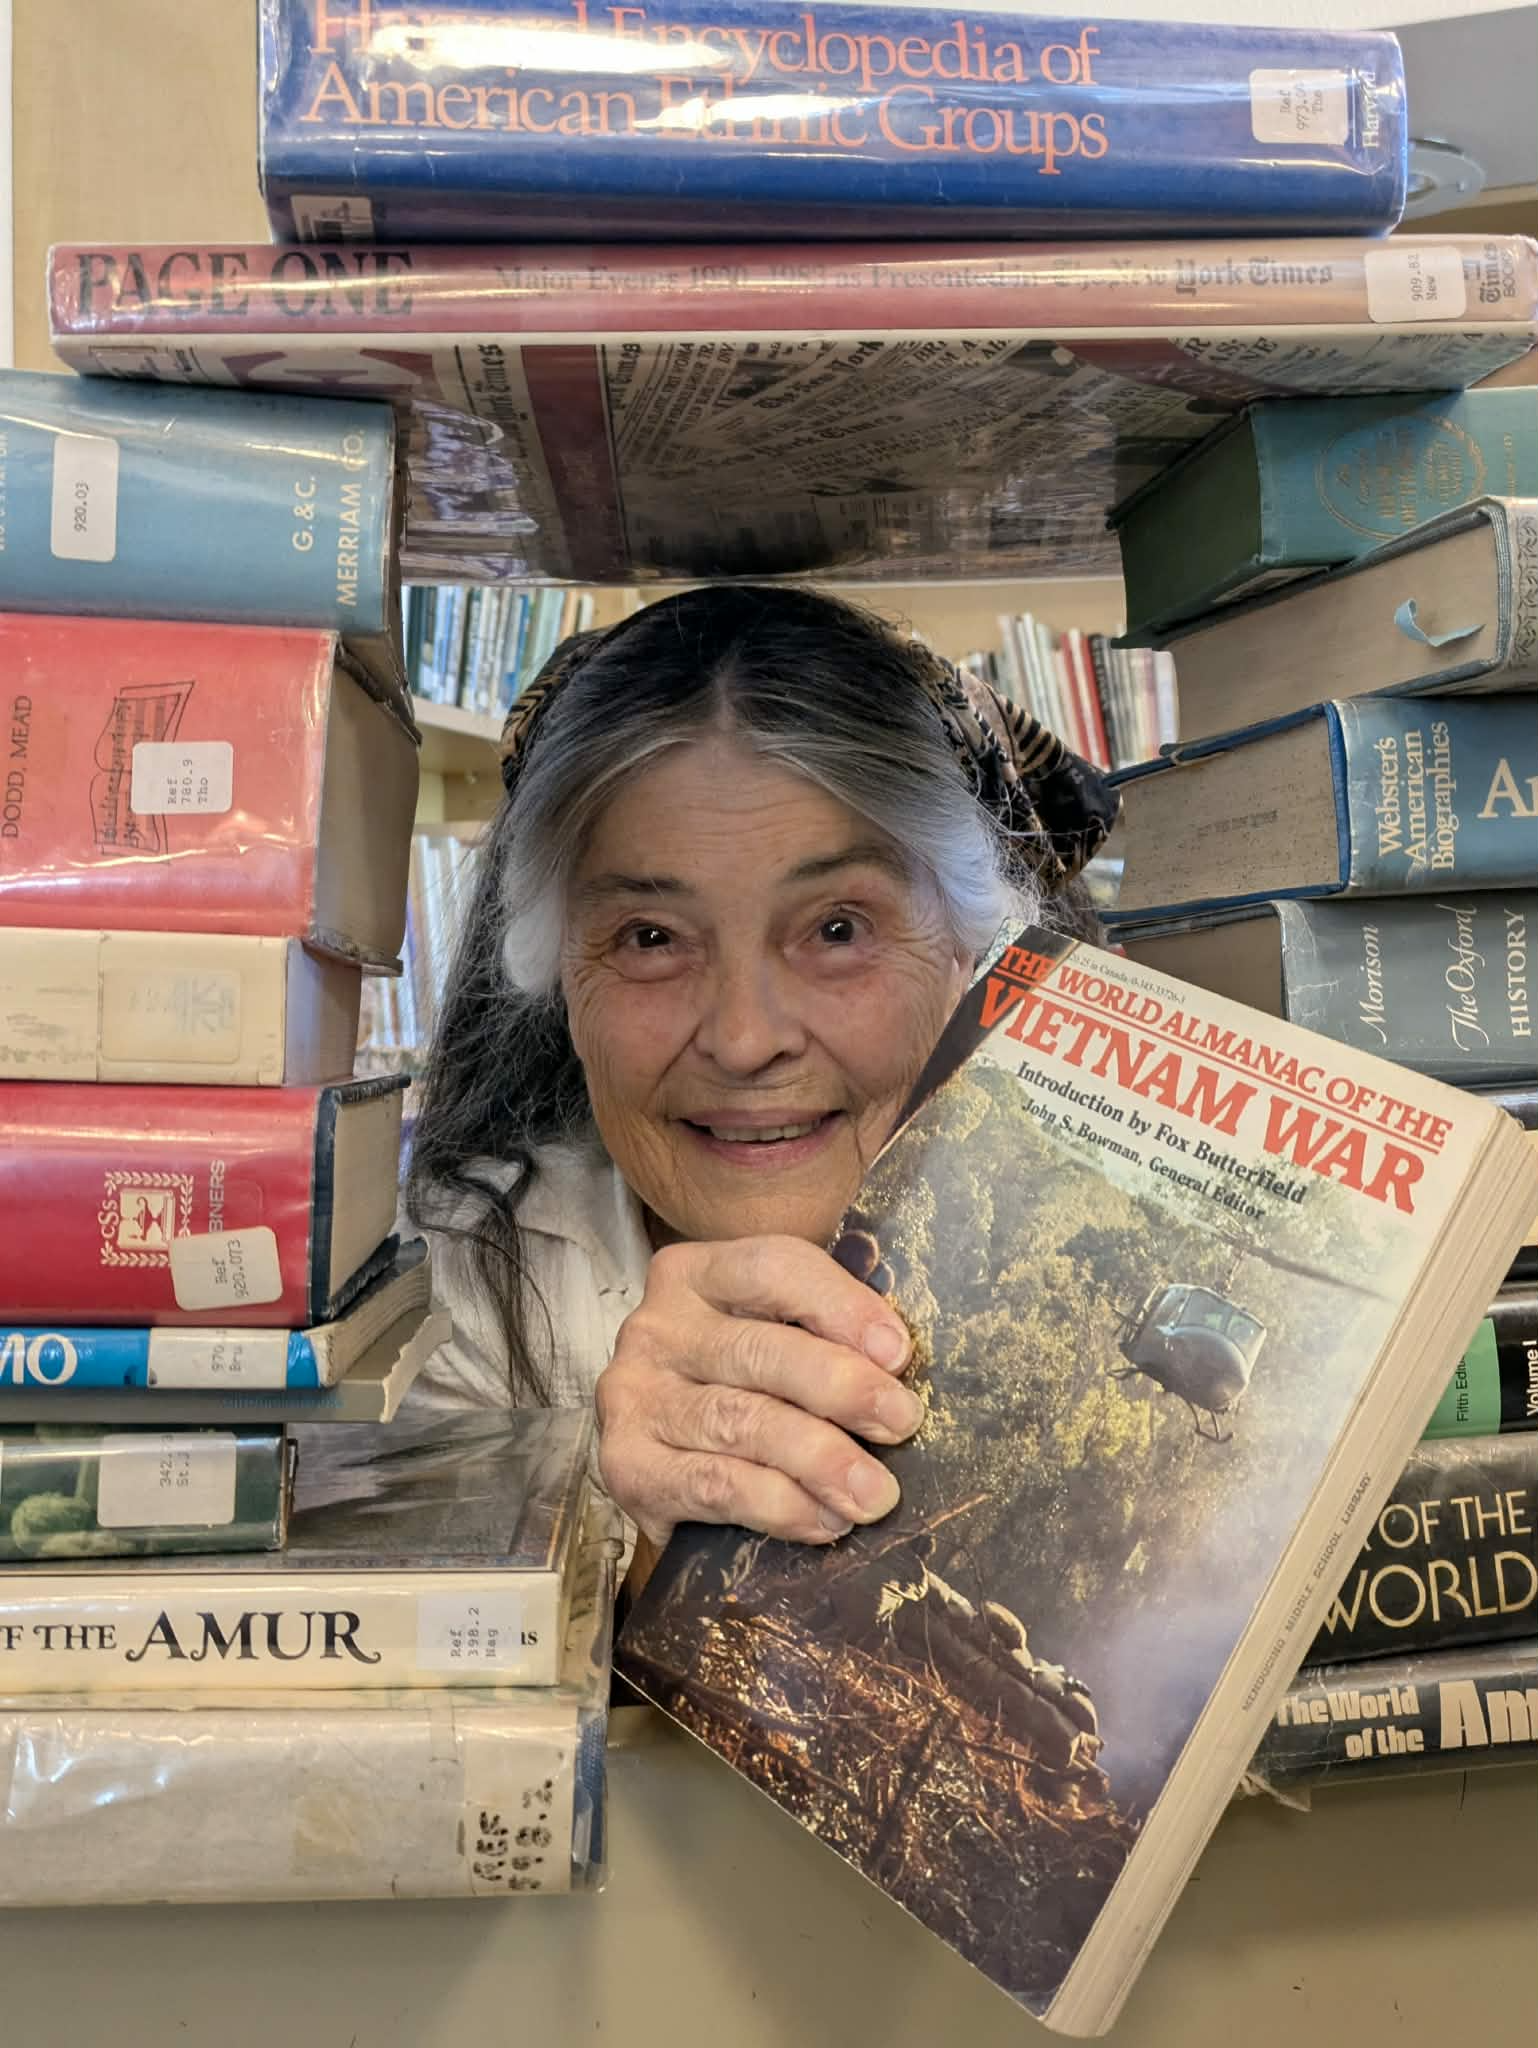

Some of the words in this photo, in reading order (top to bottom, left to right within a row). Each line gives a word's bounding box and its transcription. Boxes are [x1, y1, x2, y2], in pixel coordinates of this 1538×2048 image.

[1039, 26, 1102, 86] of
[300, 62, 637, 137] American
[655, 73, 868, 147] Ethnic
[877, 84, 1108, 174] Groups
[1360, 71, 1380, 148] Harvard
[77, 251, 248, 318] PAGE
[271, 250, 414, 317] ONE
[493, 264, 577, 296] Major
[834, 269, 863, 289] as
[872, 262, 1003, 289] Presented
[1175, 257, 1244, 297] York
[1248, 256, 1334, 286] Times
[1426, 275, 1439, 303] New
[1479, 242, 1502, 304] Times
[1503, 250, 1517, 299] BOOKS
[74, 481, 90, 533] 920.03
[294, 476, 316, 499] C.
[294, 498, 316, 521] &
[292, 525, 314, 552] G.
[337, 482, 363, 607] MERRIAM
[1, 762, 28, 840] DODD,
[18, 694, 34, 759] MEAD
[168, 775, 178, 805] Ref
[181, 758, 194, 805] 780.9
[197, 776, 209, 804] Tho
[1373, 736, 1403, 857] Webster's
[1400, 728, 1428, 865] American
[1426, 720, 1460, 871] Biographies
[1440, 903, 1487, 992] Oxford
[1500, 910, 1531, 1037] HISTORY
[1358, 922, 1387, 1045] Morison
[1000, 944, 1055, 985] THE
[1056, 965, 1164, 1024] WORLD
[1160, 1010, 1325, 1095] ALMANAC
[1325, 1078, 1378, 1112] OF
[1377, 1094, 1454, 1149] THE
[1447, 984, 1490, 1052] The
[977, 975, 1259, 1137] VIETNAM
[1262, 1095, 1426, 1215] WAR
[1016, 1061, 1136, 1123] Introduction
[1132, 1112, 1154, 1137] by
[1156, 1120, 1192, 1154] Fox
[1193, 1142, 1308, 1206] Butterfield
[1022, 1098, 1057, 1128] John
[1059, 1113, 1074, 1134] S.
[1076, 1120, 1144, 1167] Bowman,
[1149, 1155, 1208, 1195] General
[1207, 1182, 1267, 1221] Editor
[213, 1257, 229, 1284] Ref
[228, 1238, 250, 1299] 920.073
[1456, 1392, 1469, 1422] Fifth
[1526, 1348, 1538, 1417] Volume
[1378, 1498, 1443, 1549] OF
[1451, 1489, 1532, 1540] THE
[1285, 1585, 1314, 1634] MIDDLE
[1313, 1531, 1344, 1579] SCHOOL
[1341, 1472, 1372, 1525] LIBRARY
[1323, 1551, 1538, 1635] WORLD
[33, 1623, 117, 1651] THE
[126, 1610, 382, 1664] AMUR
[450, 1628, 463, 1658] Ref
[467, 1606, 480, 1658] 398.2
[1277, 1695, 1328, 1727] The
[1327, 1684, 1421, 1722] World
[1344, 1727, 1374, 1759] of
[1376, 1724, 1425, 1756] the
